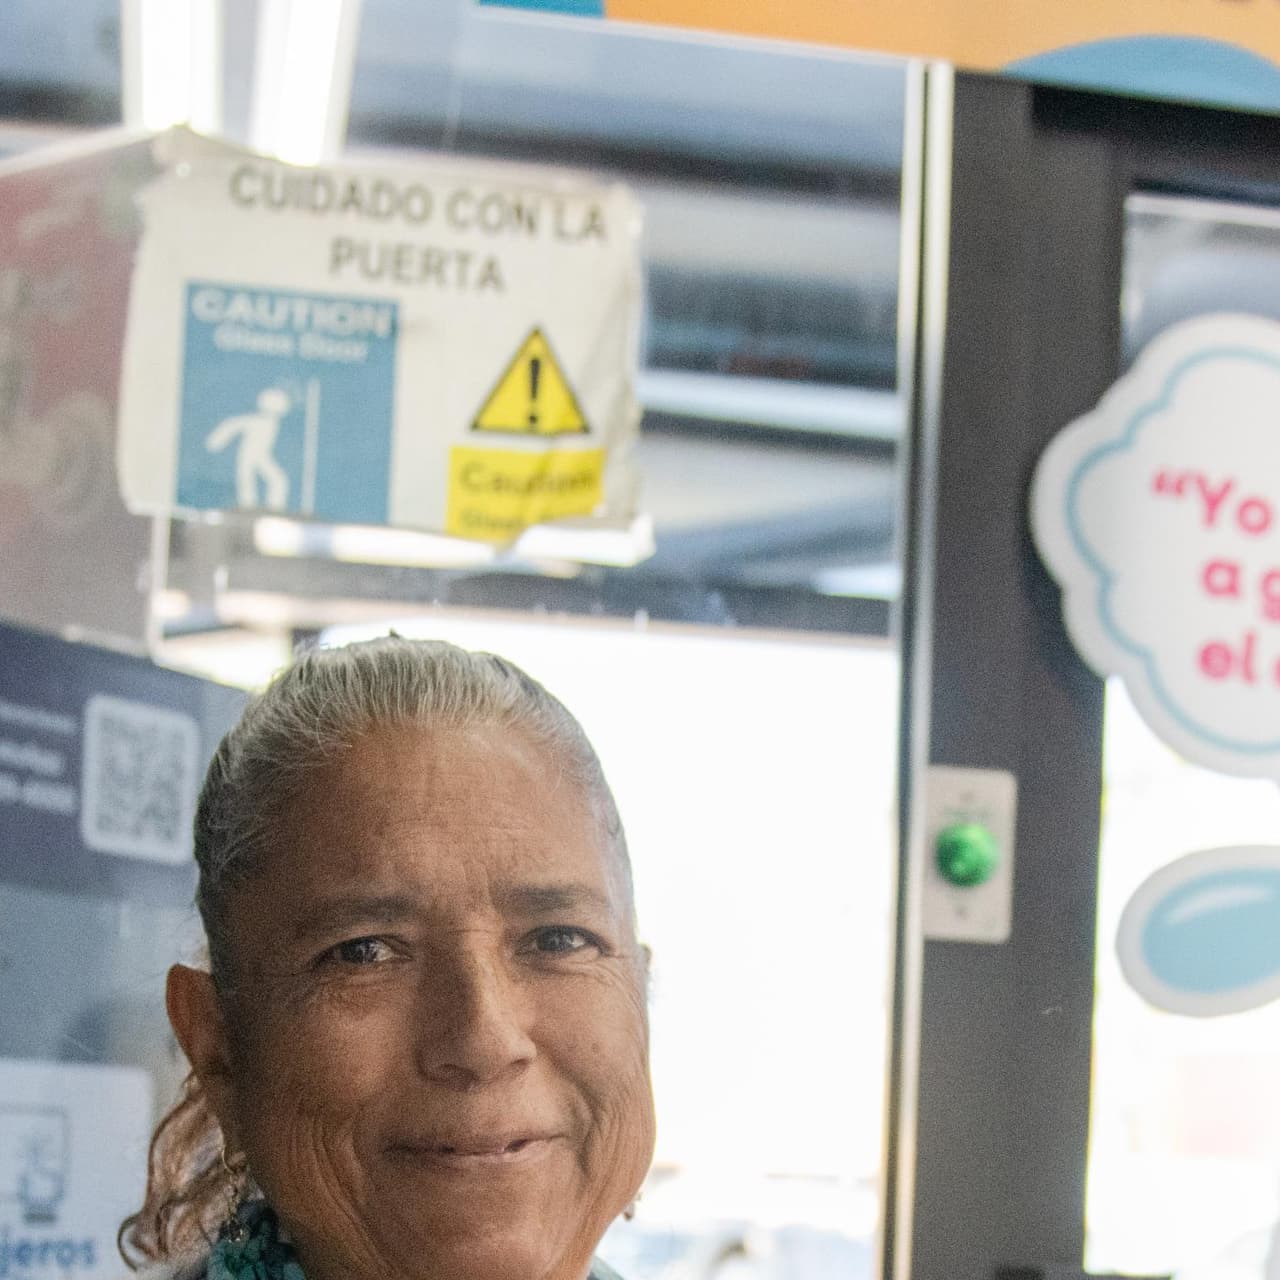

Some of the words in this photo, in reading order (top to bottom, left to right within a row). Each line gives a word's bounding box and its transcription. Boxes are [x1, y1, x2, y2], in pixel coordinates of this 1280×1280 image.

[229, 167, 435, 225] CUIDADO
[444, 190, 538, 238] CON
[552, 203, 608, 243] LA
[329, 236, 506, 293] PUERTA
[191, 287, 391, 337] CAUTION
[1201, 553, 1243, 600] a
[1198, 632, 1256, 687] el
